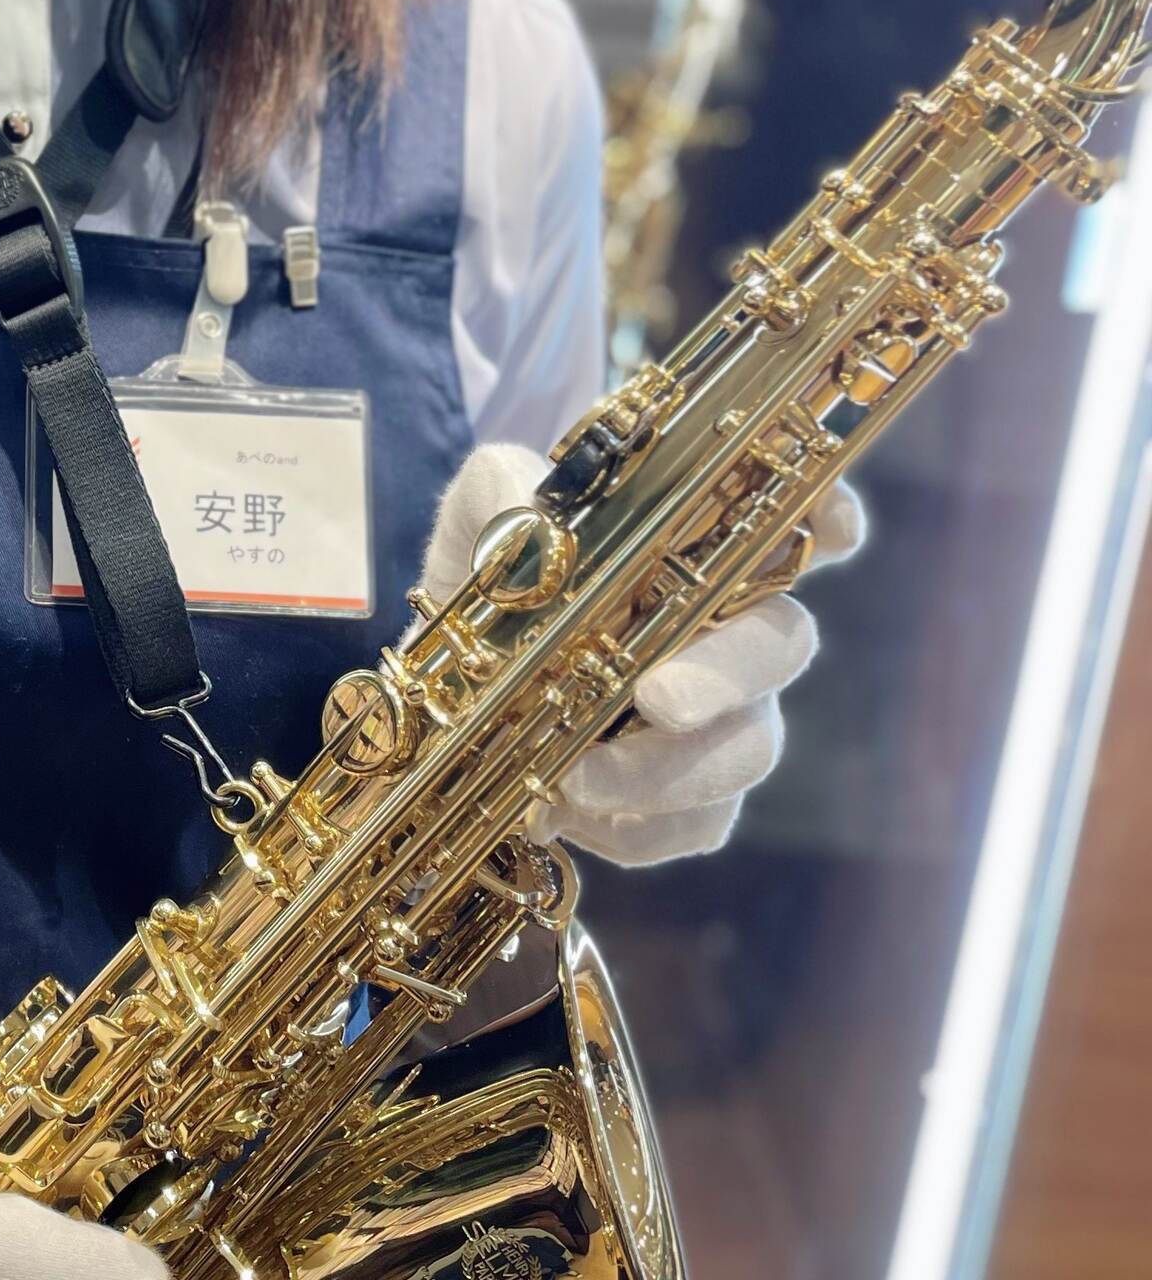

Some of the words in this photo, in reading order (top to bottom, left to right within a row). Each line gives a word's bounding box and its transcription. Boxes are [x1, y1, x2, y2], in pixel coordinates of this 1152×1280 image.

[194, 489, 286, 537] 安野
[227, 545, 285, 564] やすの
